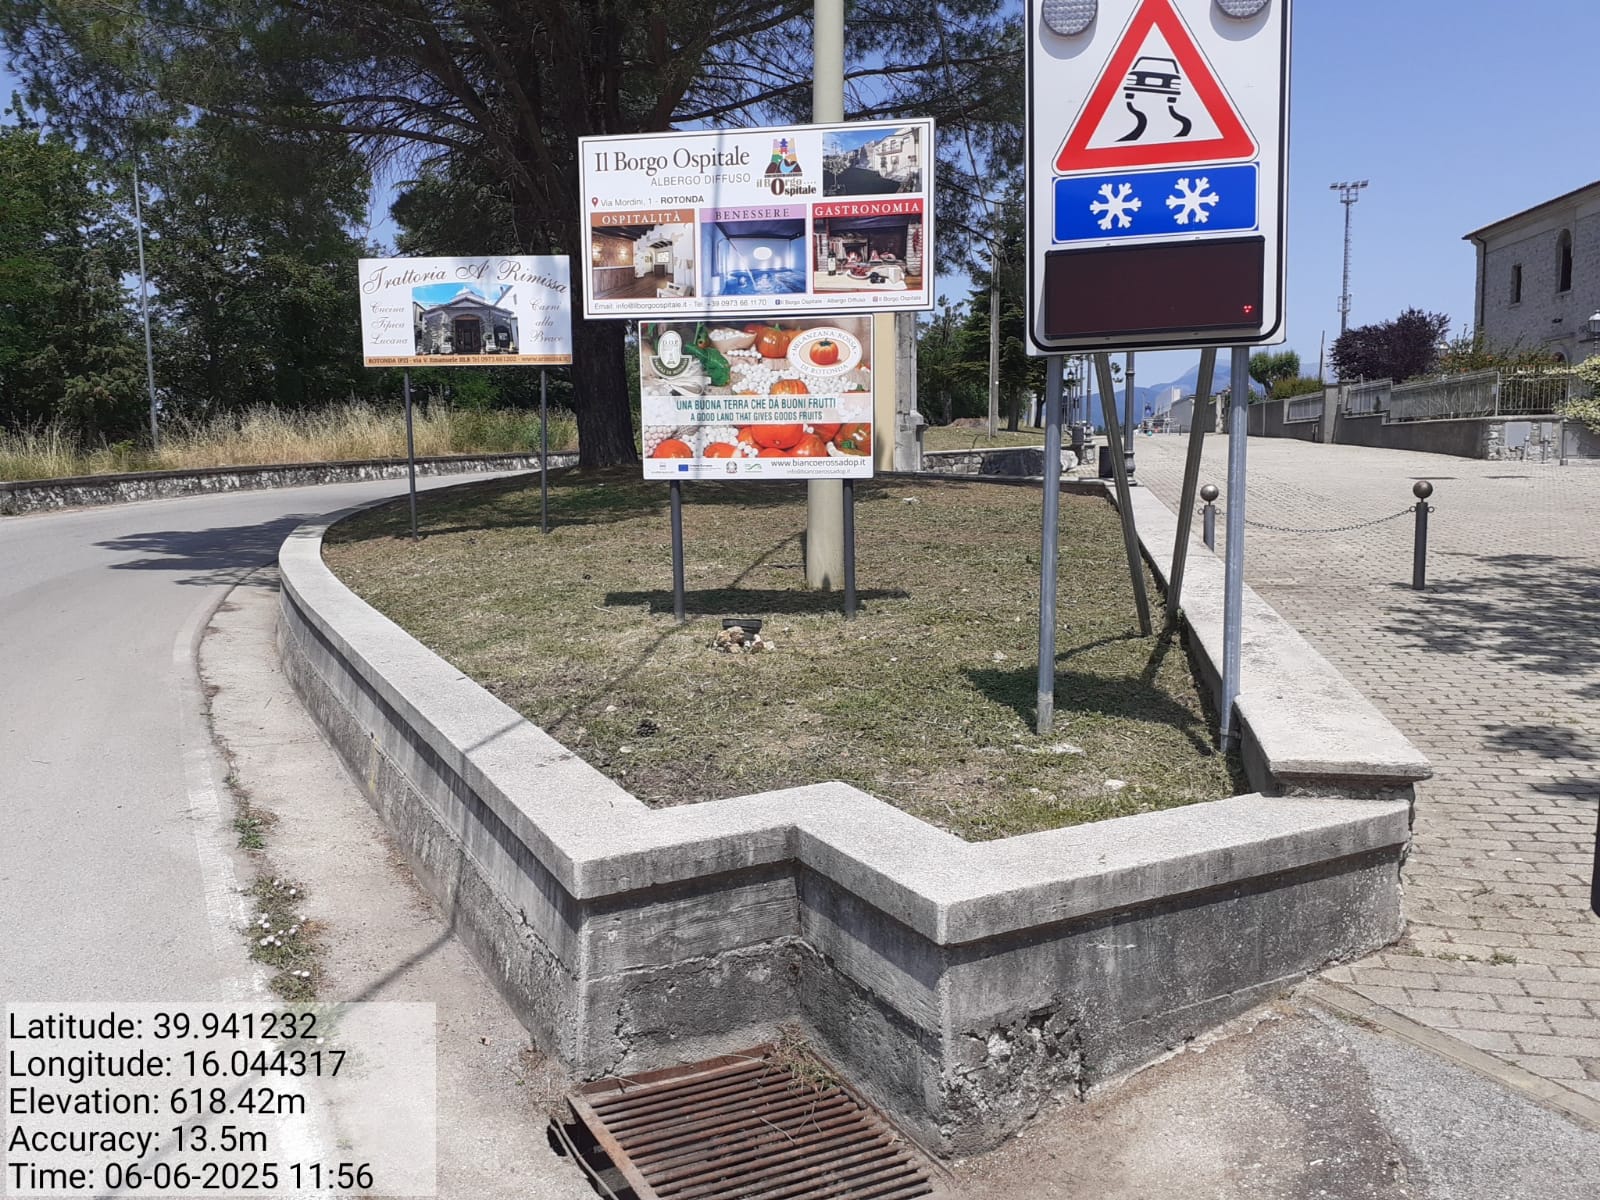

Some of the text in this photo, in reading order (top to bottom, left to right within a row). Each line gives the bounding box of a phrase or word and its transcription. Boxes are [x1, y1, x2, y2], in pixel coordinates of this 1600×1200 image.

[594, 145, 750, 177] Il Borgo Ospitale
[651, 173, 751, 187] ALBERGO DIFFUSO
[601, 199, 614, 207] Via
[661, 195, 705, 204] ROTONDA
[715, 208, 791, 221] BENESSERE
[814, 202, 921, 216] GASTRONOMIA
[602, 211, 682, 225] OSPITALITÀ
[362, 265, 448, 295] Trattoria
[497, 260, 569, 294] Rimissa
[536, 315, 554, 327] alla
[677, 400, 692, 411] UNA
[695, 399, 721, 410] BUONA
[724, 399, 749, 410] TERRA
[751, 399, 767, 410] CHE
[782, 398, 806, 409] BUONI
[808, 398, 836, 409] FRUTTI
[691, 411, 823, 421] A GOOD LAND THAT GIVES GOODS FRUITS
[771, 459, 866, 469] www.biancoerossadop.it
